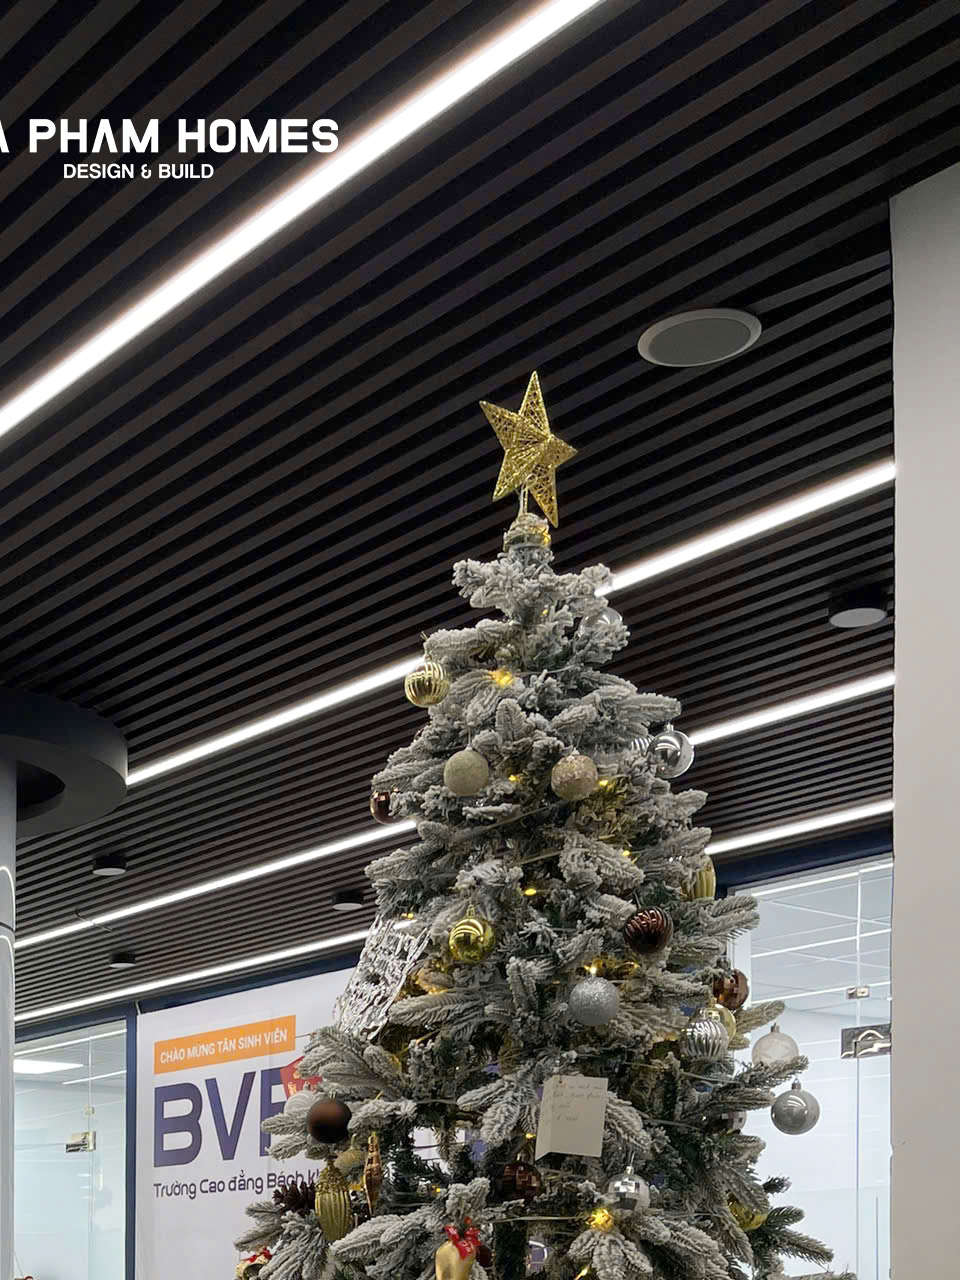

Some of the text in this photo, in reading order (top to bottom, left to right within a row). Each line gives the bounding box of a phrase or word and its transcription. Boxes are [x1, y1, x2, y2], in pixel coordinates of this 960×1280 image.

[159, 1028, 288, 1064] CHÀO MỪNG TÂN SINH VIÊN
[153, 1180, 197, 1200] Trường
[200, 1179, 226, 1194] Cao
[228, 1169, 264, 1195] đẳng
